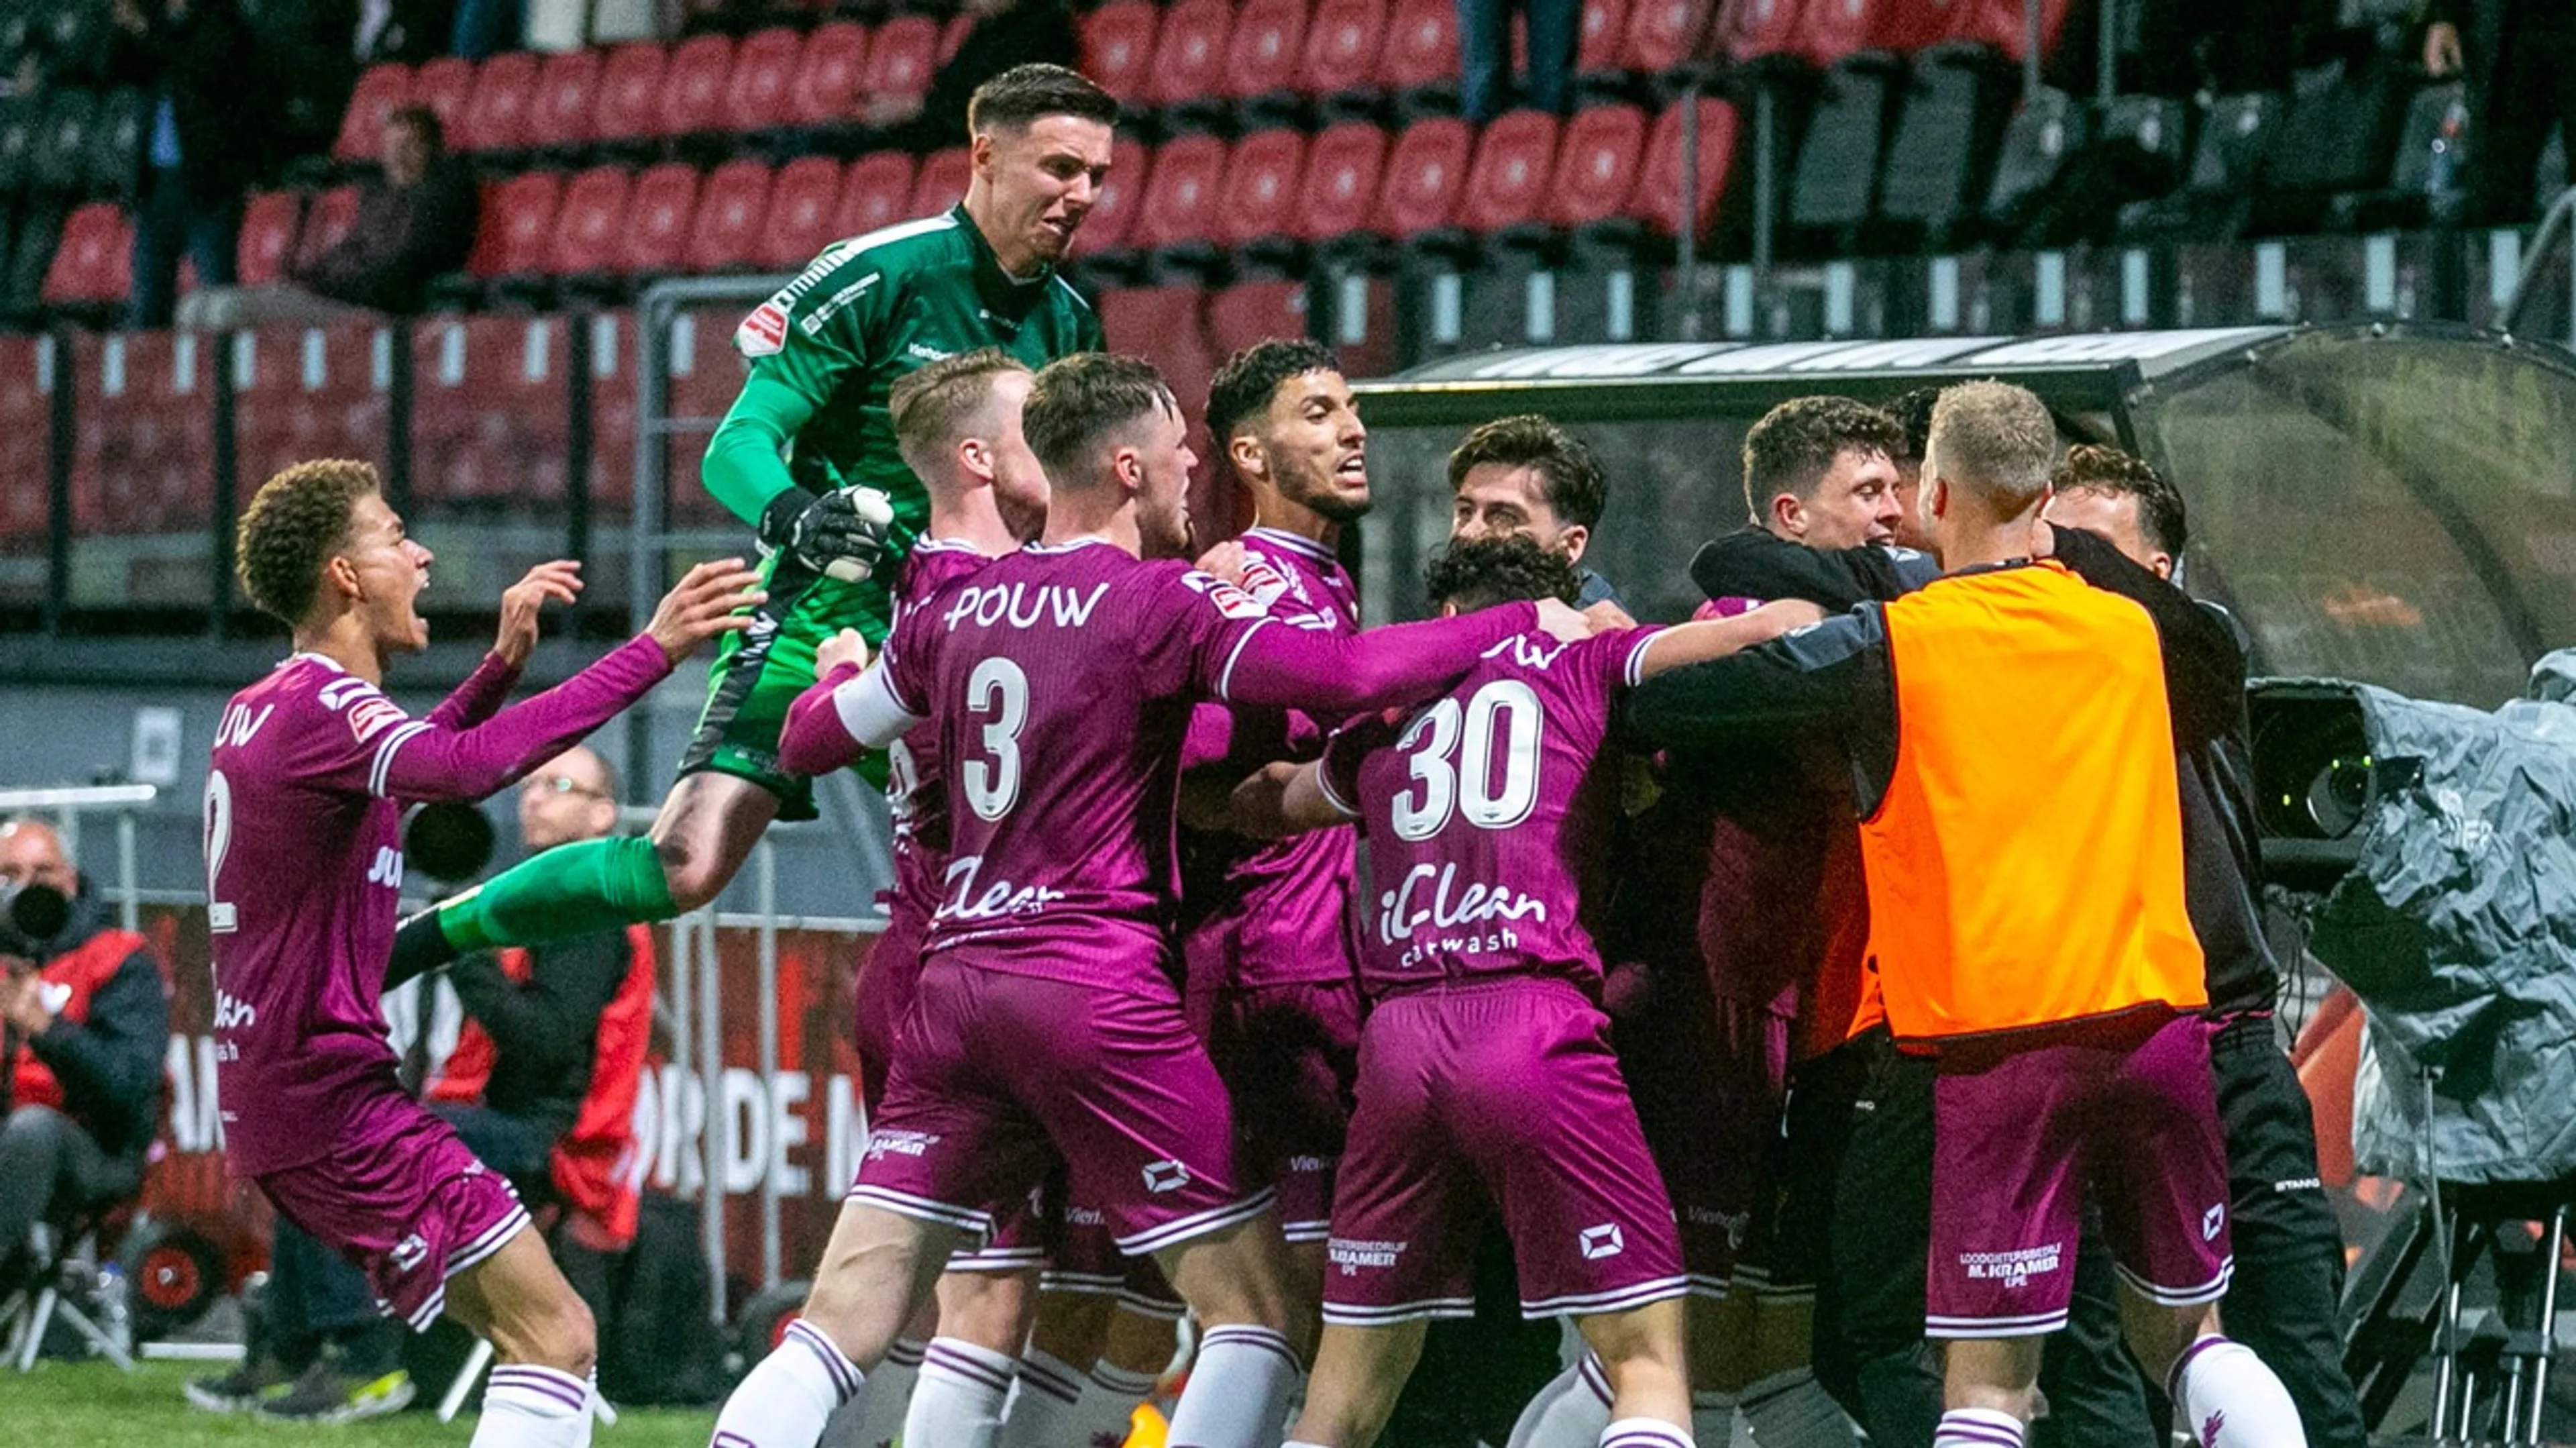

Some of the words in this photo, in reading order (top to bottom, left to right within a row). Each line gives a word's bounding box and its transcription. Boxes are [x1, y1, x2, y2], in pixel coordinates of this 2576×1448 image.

[944, 582, 1109, 631] POUW
[962, 656, 1029, 823] 3
[1391, 678, 1544, 842] 30
[1380, 862, 1546, 945] iClean
[1401, 928, 1518, 968] carwash
[1988, 1255, 2059, 1278] KRAMER
